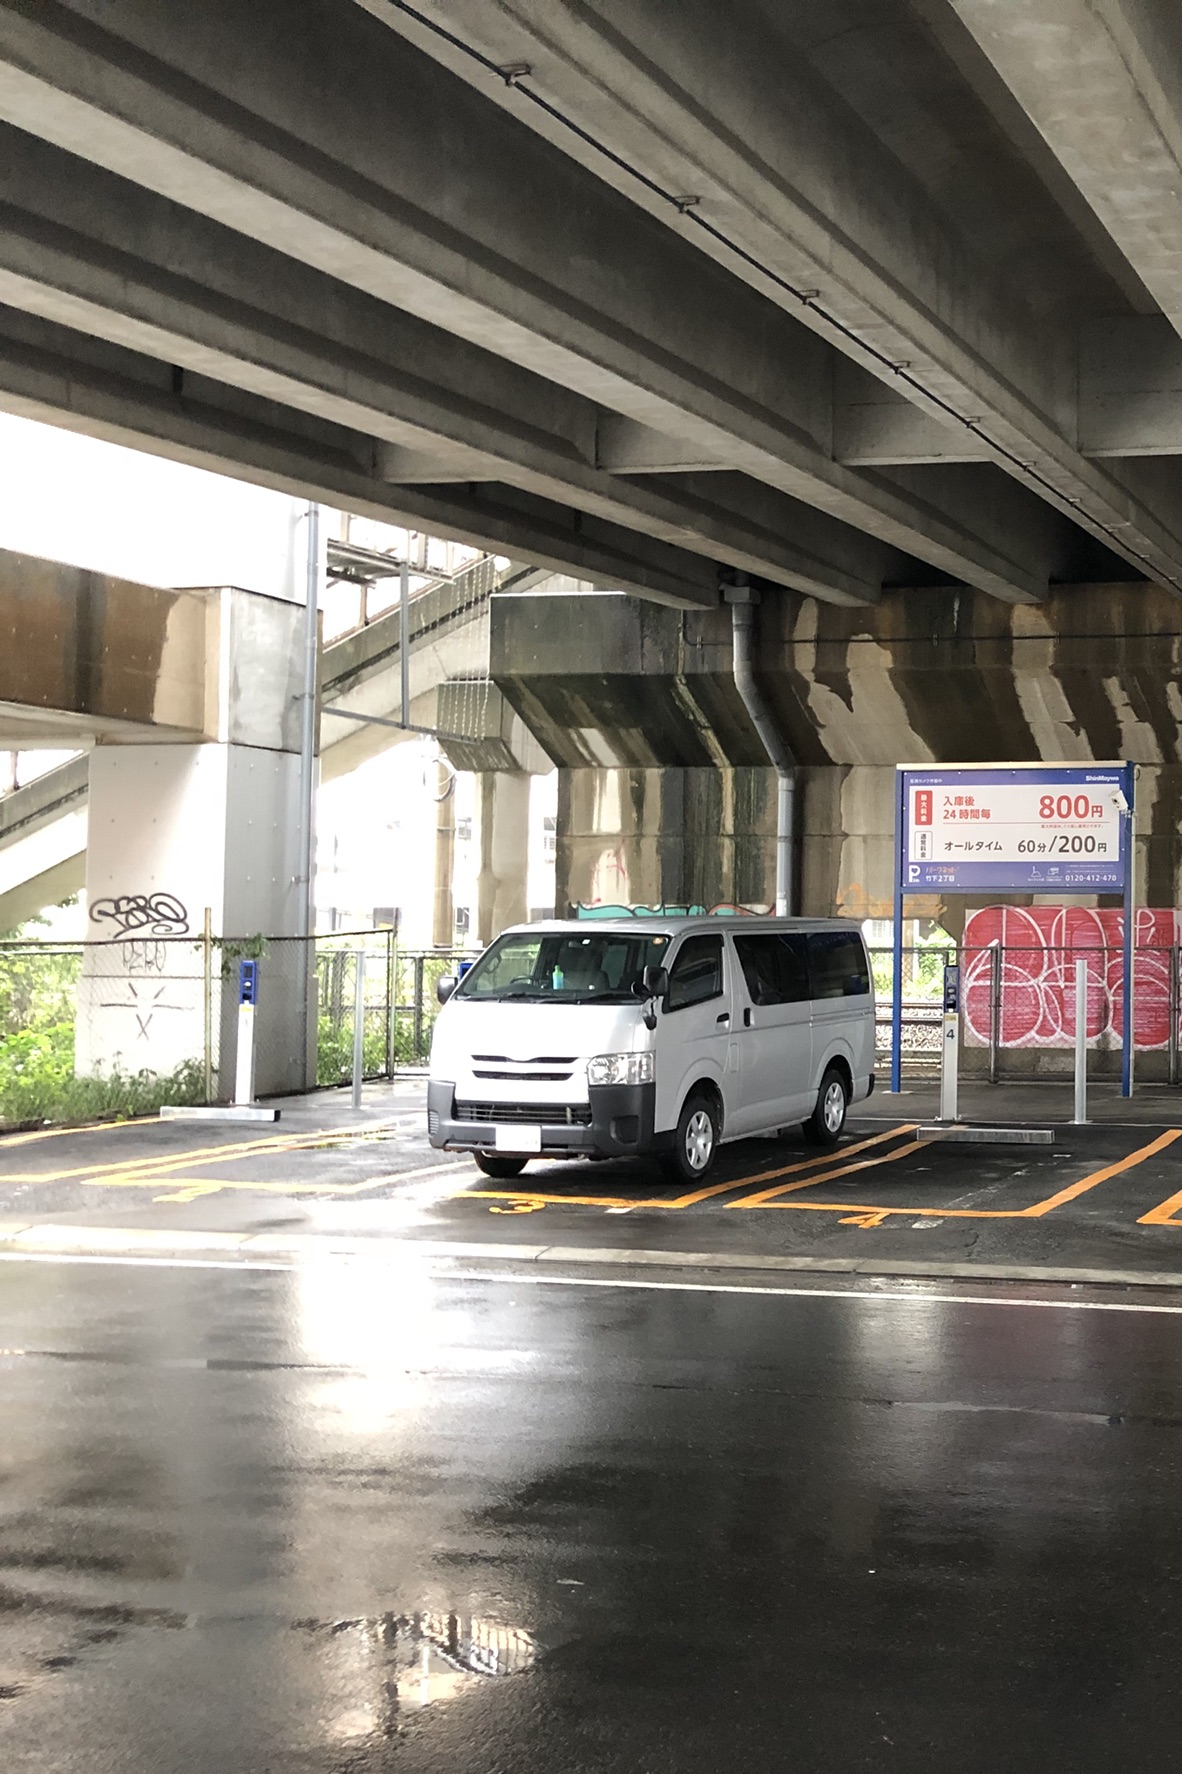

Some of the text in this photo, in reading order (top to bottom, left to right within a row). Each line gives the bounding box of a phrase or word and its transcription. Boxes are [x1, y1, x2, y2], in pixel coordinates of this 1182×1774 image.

[943, 796, 975, 806] 入庫後
[1039, 795, 1103, 818] 800円
[944, 841, 1003, 851] オールタイム
[946, 1029, 955, 1040] 4
[489, 1200, 545, 1213] 3
[837, 1212, 890, 1228] 4
